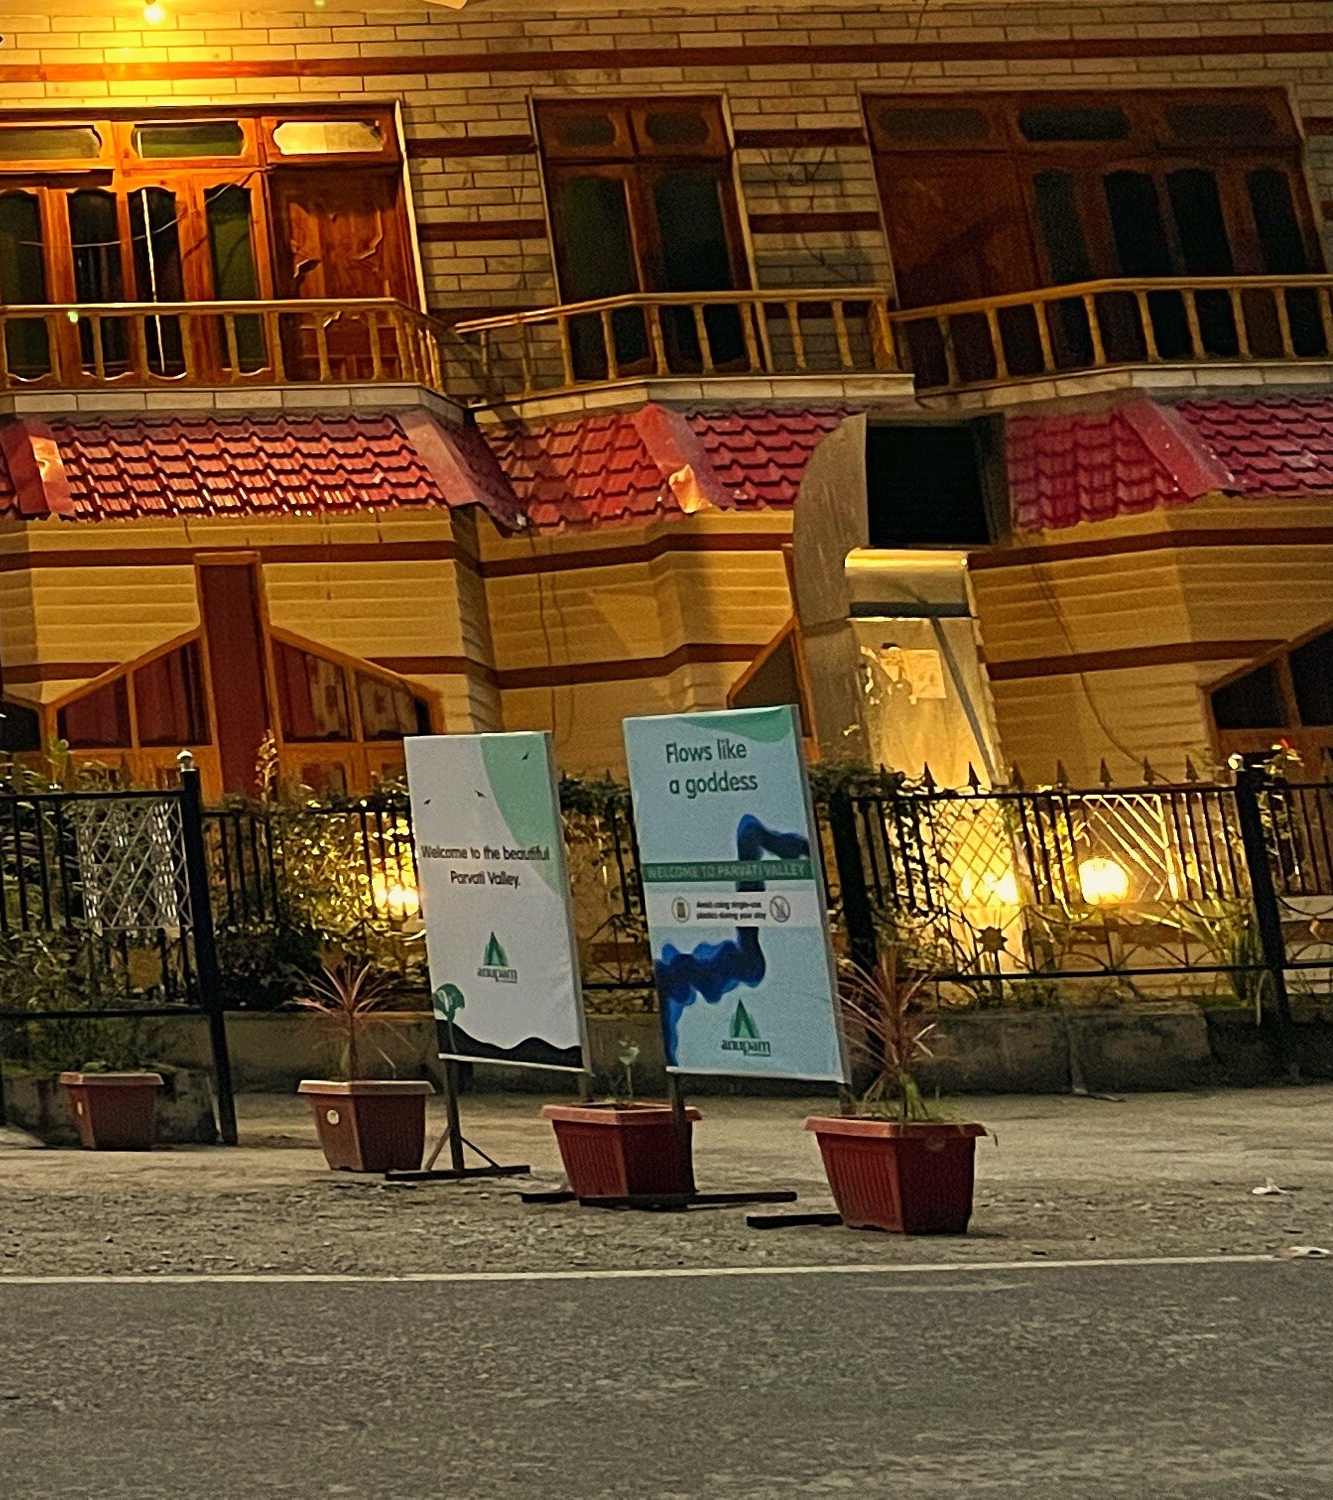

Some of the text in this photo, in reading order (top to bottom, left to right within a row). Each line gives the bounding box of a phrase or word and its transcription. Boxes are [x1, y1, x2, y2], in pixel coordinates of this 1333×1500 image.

[666, 738, 747, 763] Flows like
[669, 770, 758, 799] a goddess
[421, 845, 550, 860] Welcome to the beautiful
[450, 870, 485, 885] Parvati
[646, 863, 805, 878] WELCOME TO PARVATI VALLEY
[721, 1039, 771, 1056] anupam
